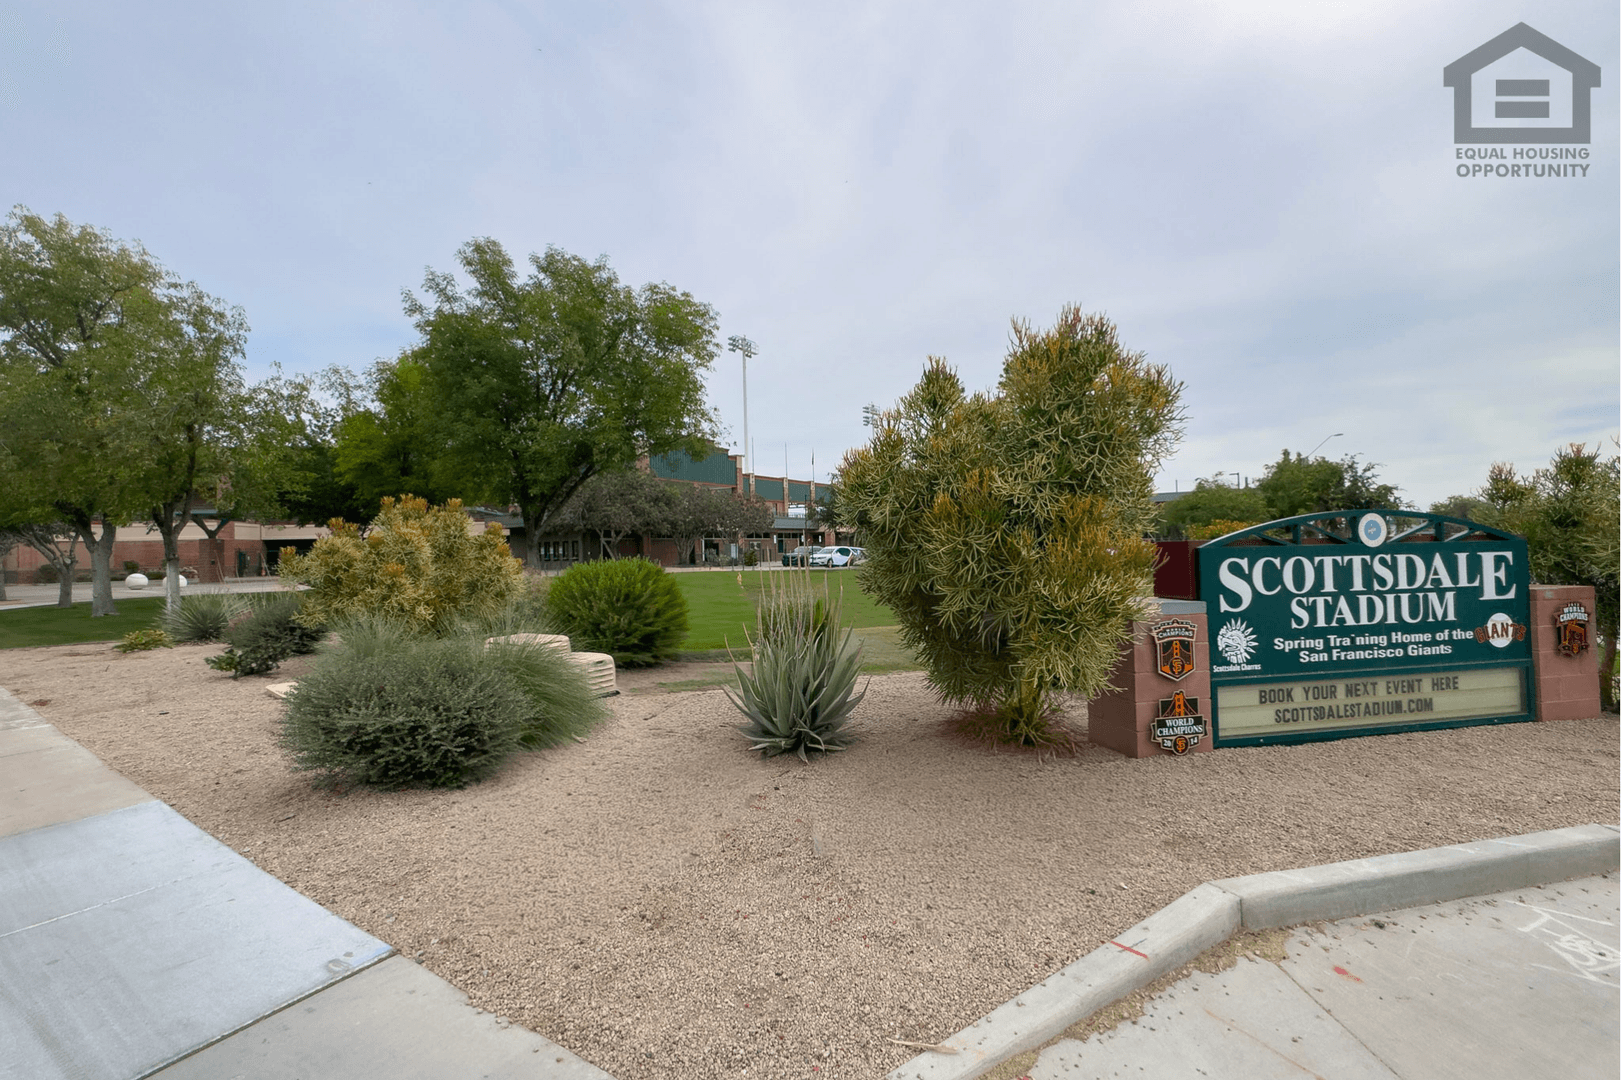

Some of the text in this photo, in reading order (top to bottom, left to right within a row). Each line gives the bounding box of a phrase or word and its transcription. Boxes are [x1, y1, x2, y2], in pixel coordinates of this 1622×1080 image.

[1219, 551, 1516, 613] SCOTTSDALE
[1290, 591, 1457, 629] STADIUM
[1158, 630, 1193, 638] CHAMPIONS
[1273, 628, 1474, 653] Spring Traning Home of the
[1474, 622, 1527, 643] GIANTS
[1299, 644, 1452, 663] San Francisco Giants
[1213, 664, 1241, 673] Scottsdale
[1258, 676, 1459, 704] BOOK YOUR NEXT EVENT HERE
[1275, 698, 1433, 723] SCOTTSDALESTADIUM.COM
[1157, 724, 1203, 736] CHAMPIONS
[1165, 717, 1194, 727] WORLD
